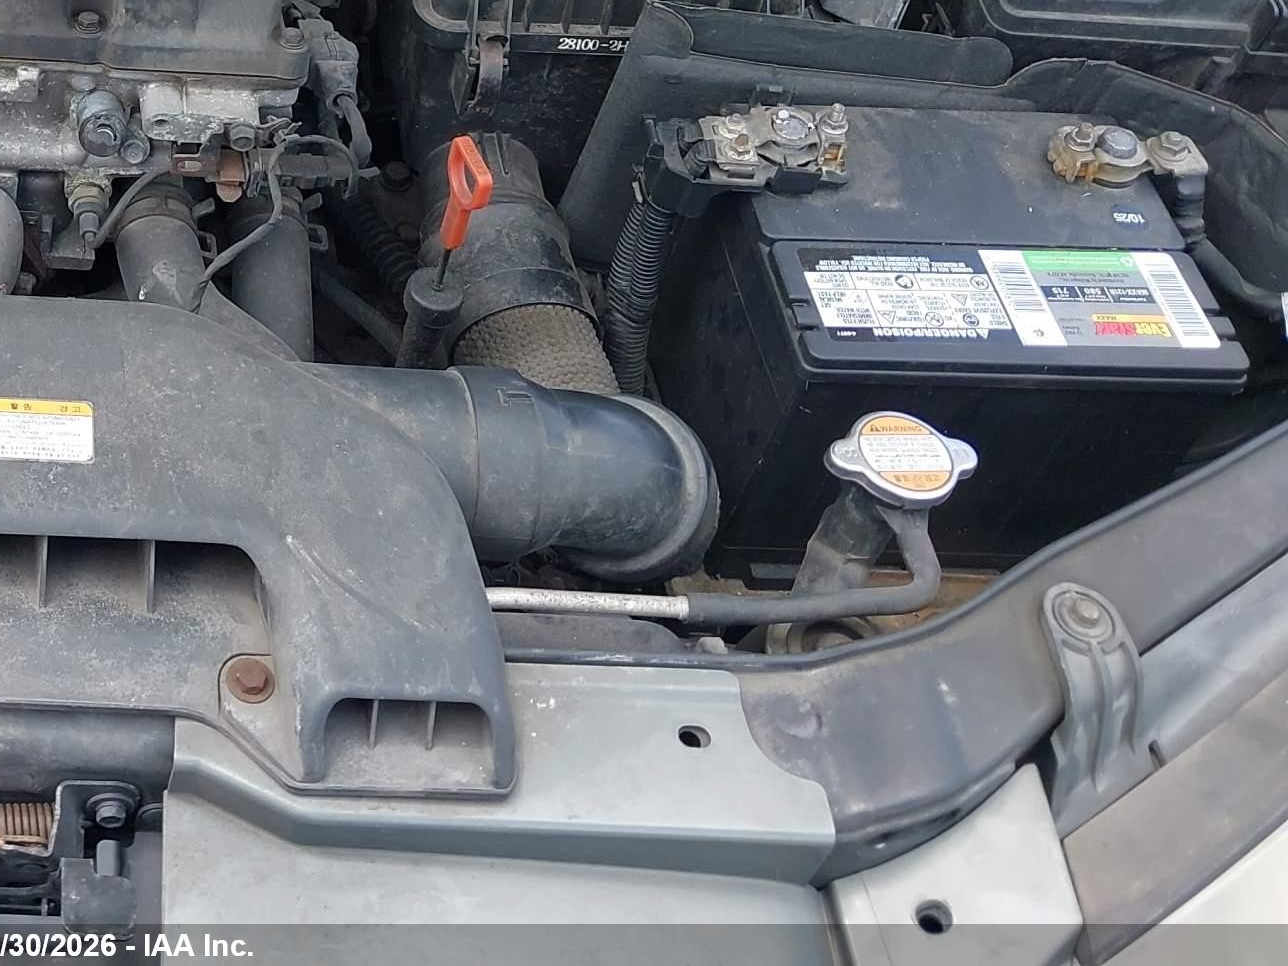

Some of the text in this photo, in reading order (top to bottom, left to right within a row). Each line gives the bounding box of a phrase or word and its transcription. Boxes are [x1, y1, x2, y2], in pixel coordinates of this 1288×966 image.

[1112, 212, 1146, 224] 10/25
[1051, 286, 1069, 294] 715
[880, 424, 922, 433] WARNING
